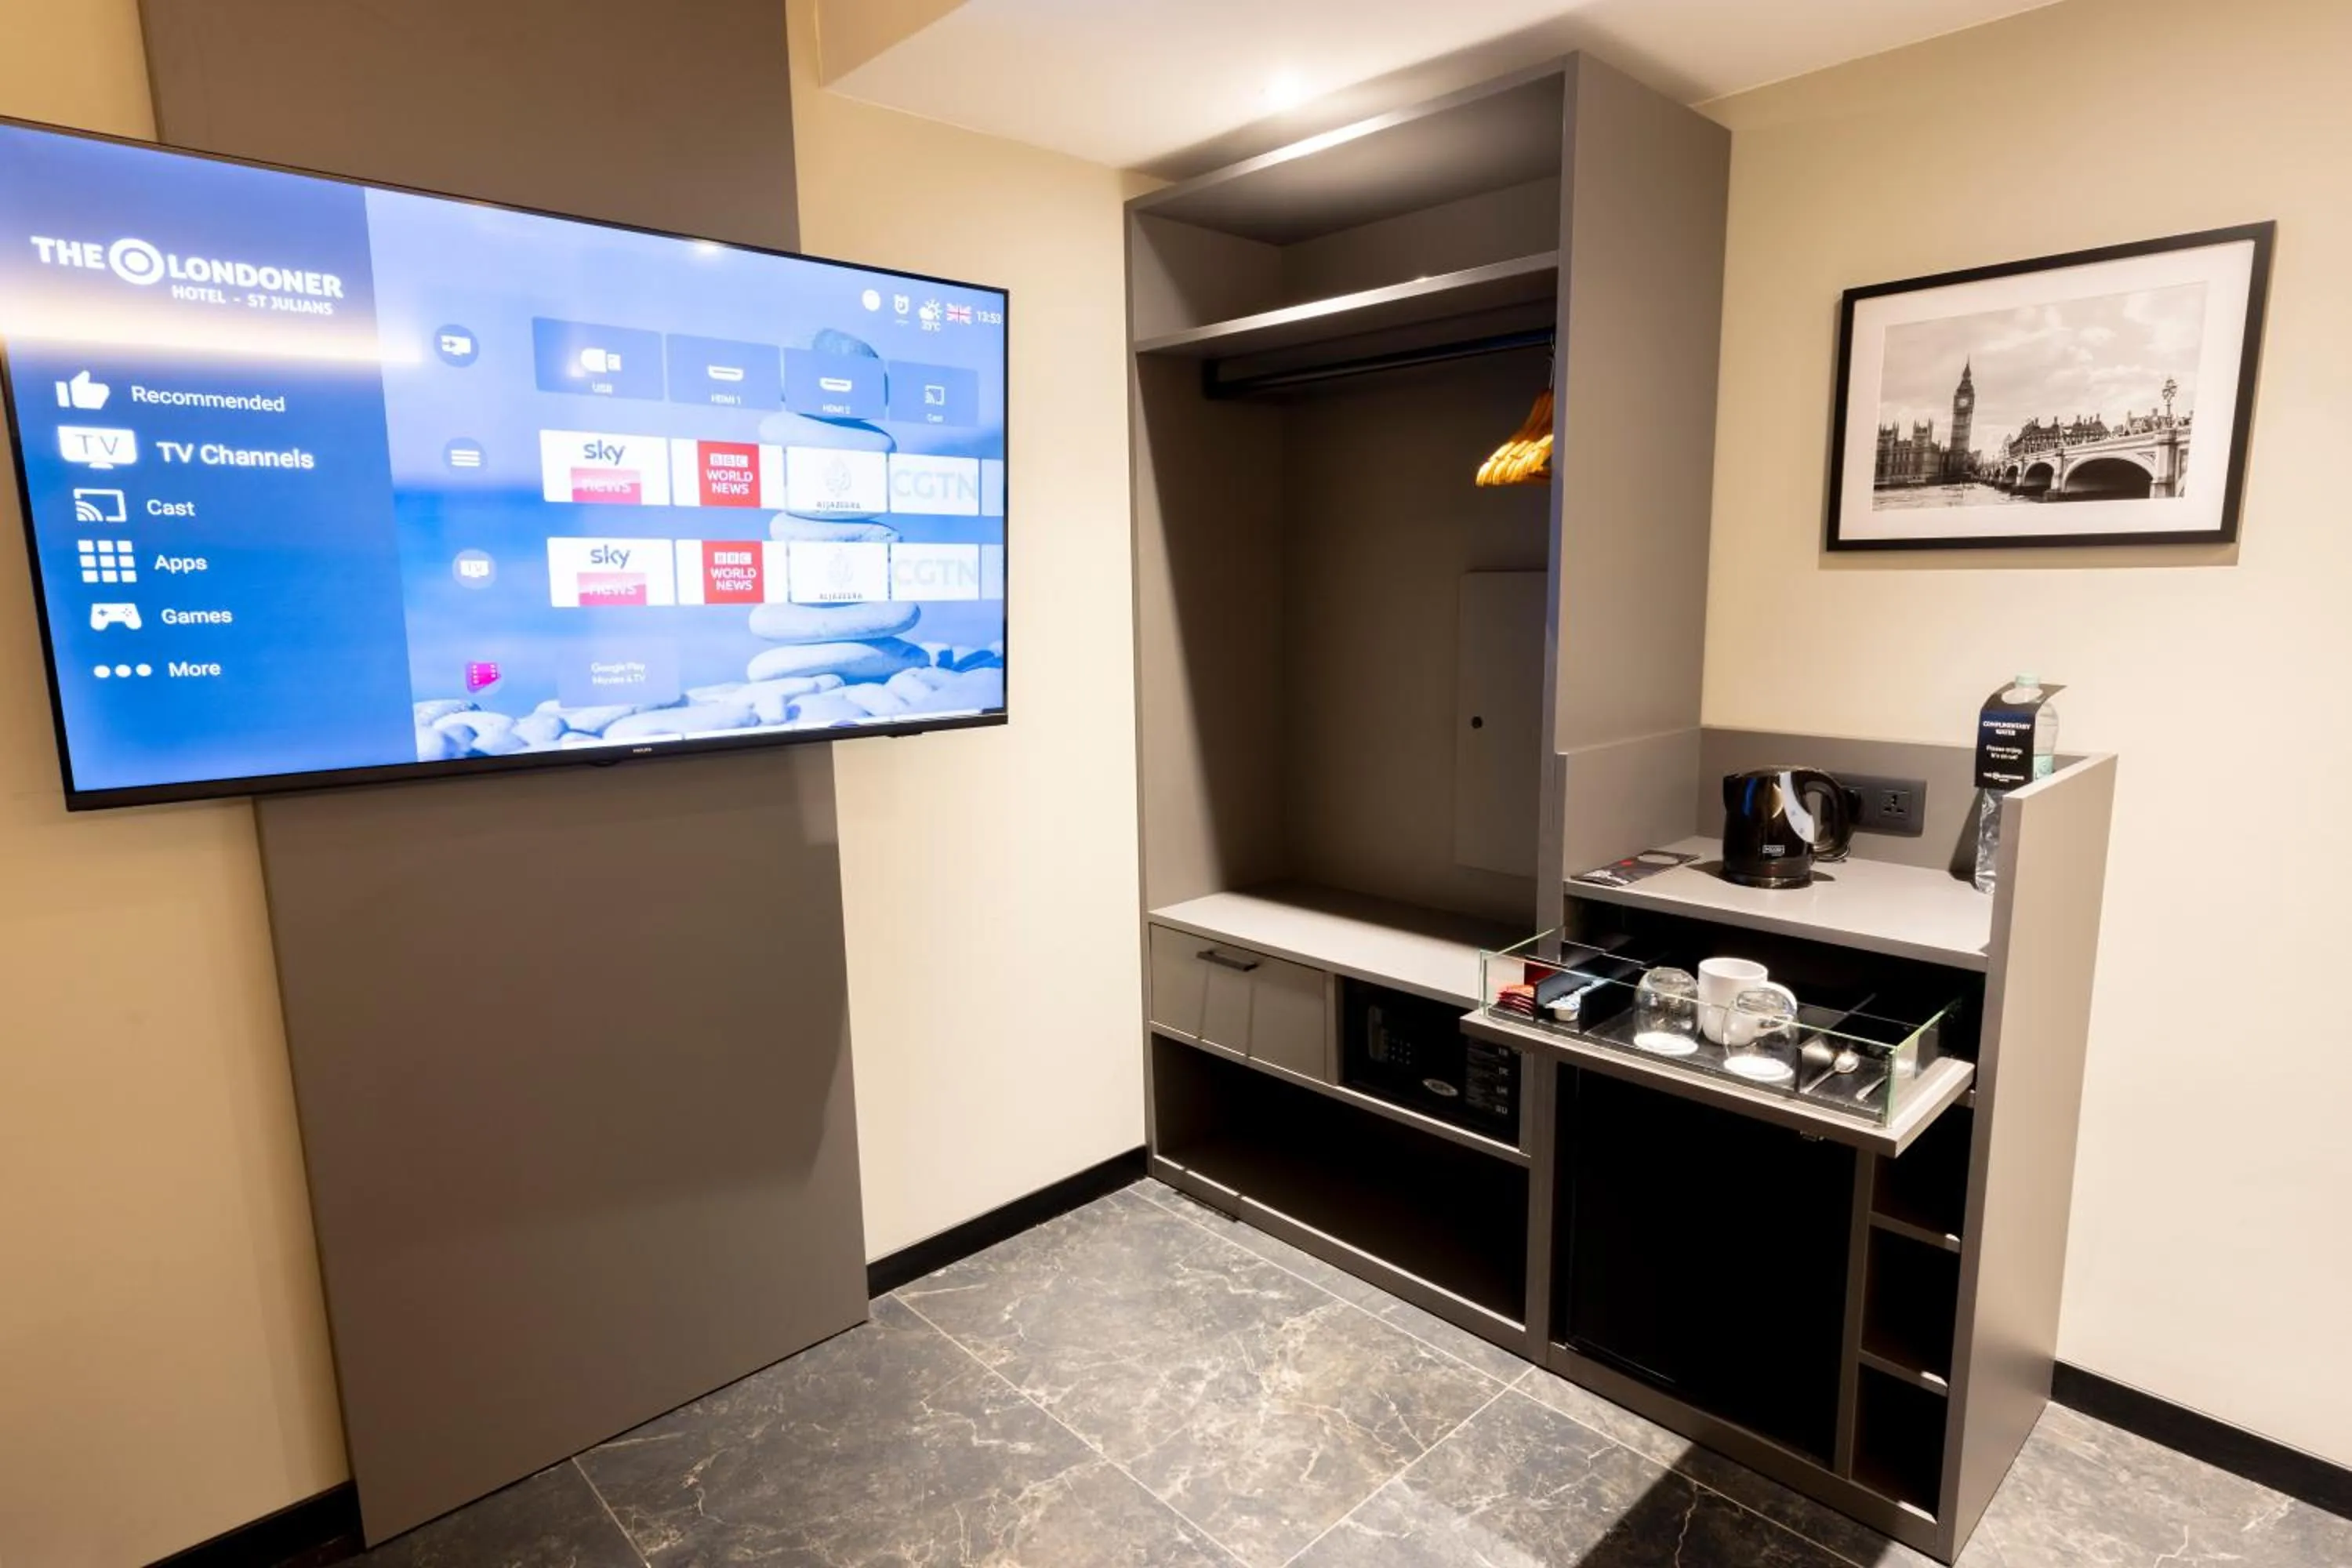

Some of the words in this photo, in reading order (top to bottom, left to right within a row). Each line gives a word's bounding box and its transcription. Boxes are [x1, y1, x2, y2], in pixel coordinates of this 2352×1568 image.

[30, 236, 107, 269] THE
[168, 253, 343, 299] LONDONER
[172, 284, 226, 303] HOTEL
[247, 293, 267, 308] ST
[271, 296, 333, 315] JULIANS
[131, 385, 286, 412] Recommended
[75, 434, 119, 456] TV
[157, 441, 194, 463] TV
[201, 443, 314, 469] Channels
[583, 440, 626, 466] sky
[706, 469, 753, 482] WORLD
[893, 469, 978, 500] CGTN
[712, 482, 750, 495] NEWS
[147, 499, 196, 517] Cast
[154, 554, 208, 574] Apps
[590, 544, 631, 569] sky
[710, 568, 757, 579] WORLD
[894, 558, 978, 586] CGTN
[716, 579, 753, 591] NEWS
[161, 608, 233, 625] Games
[169, 662, 221, 677] More
